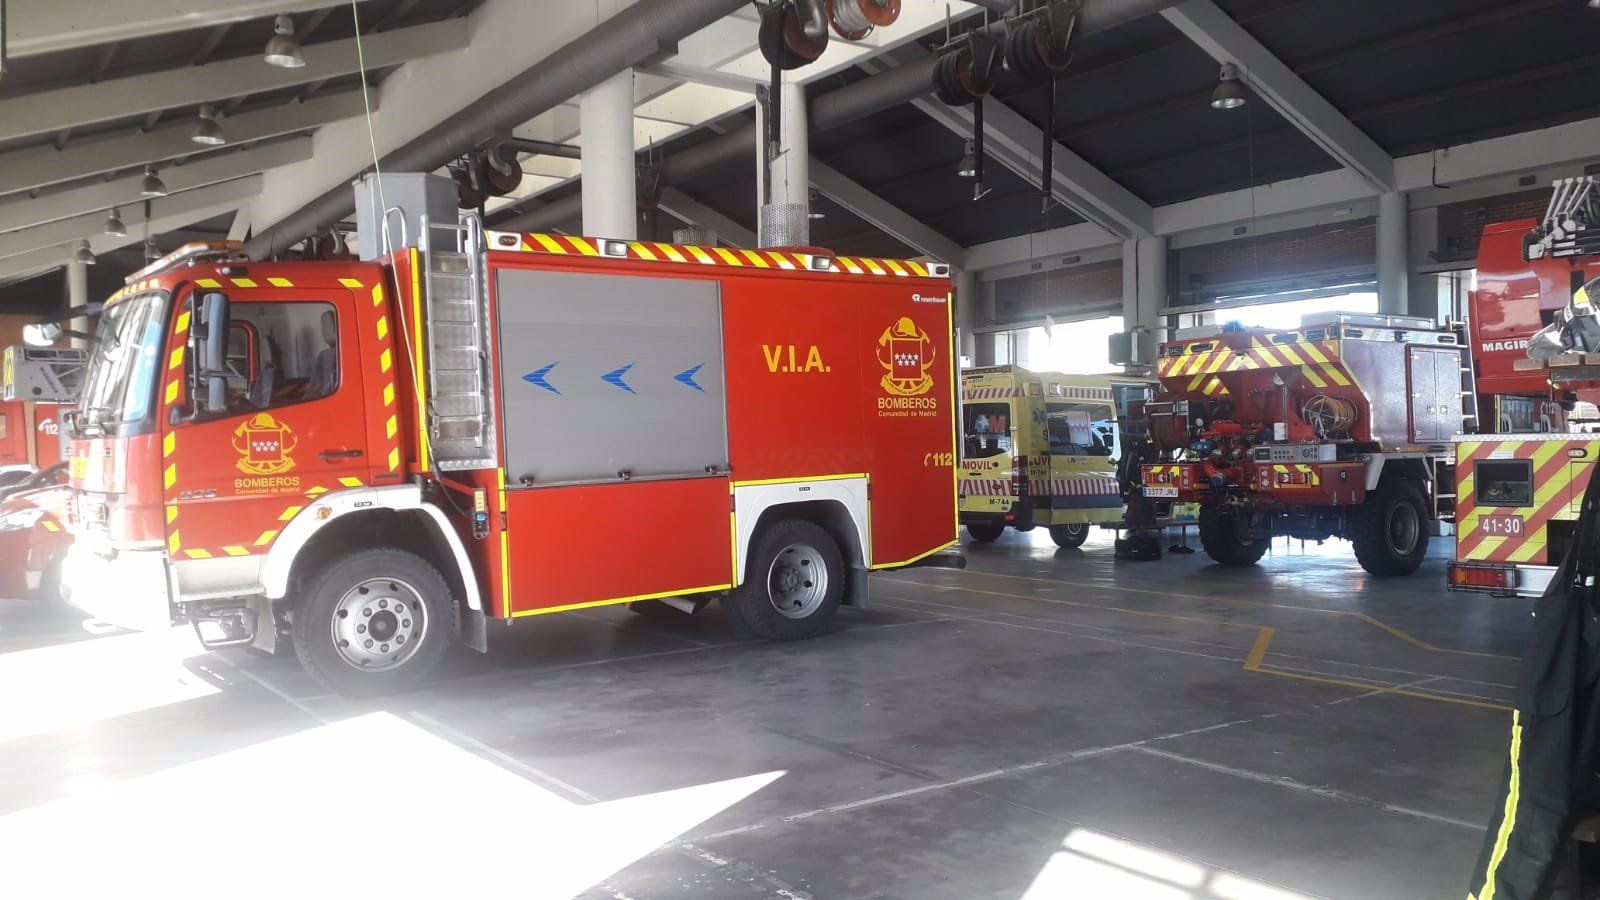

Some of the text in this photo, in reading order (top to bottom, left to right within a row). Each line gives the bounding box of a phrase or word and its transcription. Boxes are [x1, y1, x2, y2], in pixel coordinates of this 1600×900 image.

[1482, 340, 1529, 352] MAGIR
[762, 344, 831, 373] V.I.A.
[878, 397, 937, 409] BOMBEROS
[45, 424, 58, 435] 112
[933, 452, 953, 467] 112
[234, 476, 300, 488] BOMBEROS
[1482, 518, 1520, 533] 41-30
